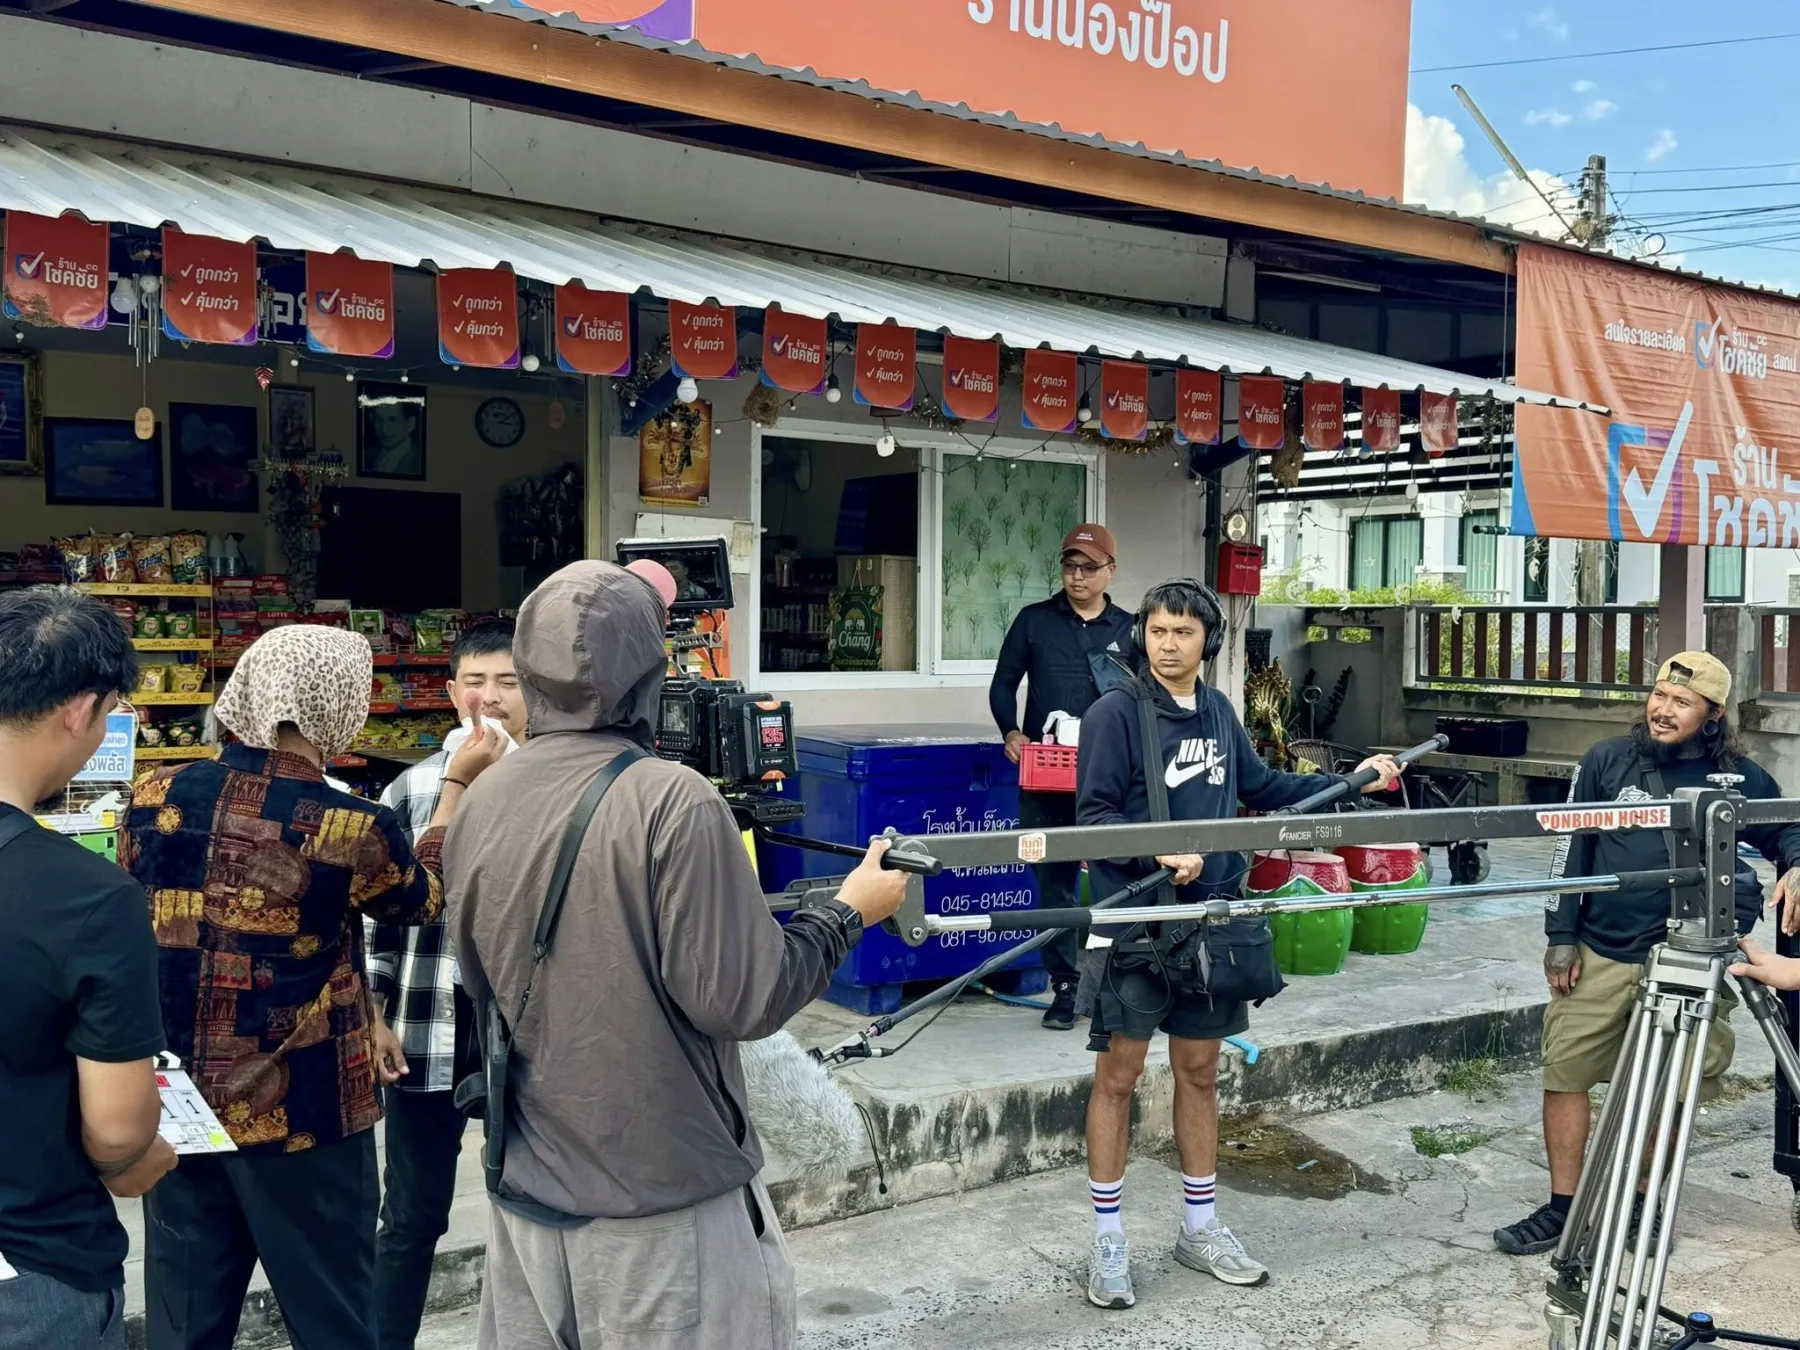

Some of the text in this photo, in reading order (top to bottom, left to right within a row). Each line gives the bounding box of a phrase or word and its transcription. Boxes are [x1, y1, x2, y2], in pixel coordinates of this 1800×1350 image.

[58, 257, 76, 270] ร้าน
[44, 261, 98, 289] โชคชัย
[196, 267, 239, 285] ถูกกว่า
[196, 291, 239, 312] คุ้มกว่า
[351, 293, 367, 305] ร้าน
[465, 296, 503, 313] ถูกกว่า
[340, 299, 385, 321] โชคชัย
[466, 320, 504, 340] คุ้มกว่า
[593, 317, 607, 328] ร้าน
[692, 313, 723, 331] ถูกกว่า
[583, 321, 623, 342] โชคชัย
[1604, 318, 1686, 353] สนใจรายละเอียด
[1732, 325, 1749, 348] ร้าน
[694, 336, 725, 354] คุ้มกว่า
[787, 342, 821, 364] โชคชัย
[795, 339, 808, 350] ร้าน
[876, 348, 904, 362] ถูกกว่า
[1719, 334, 1767, 379] โชคชัย
[875, 367, 904, 383] คุ้มกว่า
[963, 374, 993, 393] โชคชัย
[1041, 375, 1067, 389] ถูกกว่า
[1041, 392, 1067, 408] คุ้มกว่า
[1119, 396, 1144, 412] โชคชัย
[1191, 390, 1212, 403] ถูกกว่า
[1190, 408, 1212, 422] คุ้มกว่า
[1733, 424, 1778, 490] ร้าน
[838, 630, 871, 652] Chang
[1540, 808, 1667, 830] PONBOON HOUSE
[1286, 825, 1343, 841] FANCIER FS9116
[941, 889, 1032, 913] 045-814540
